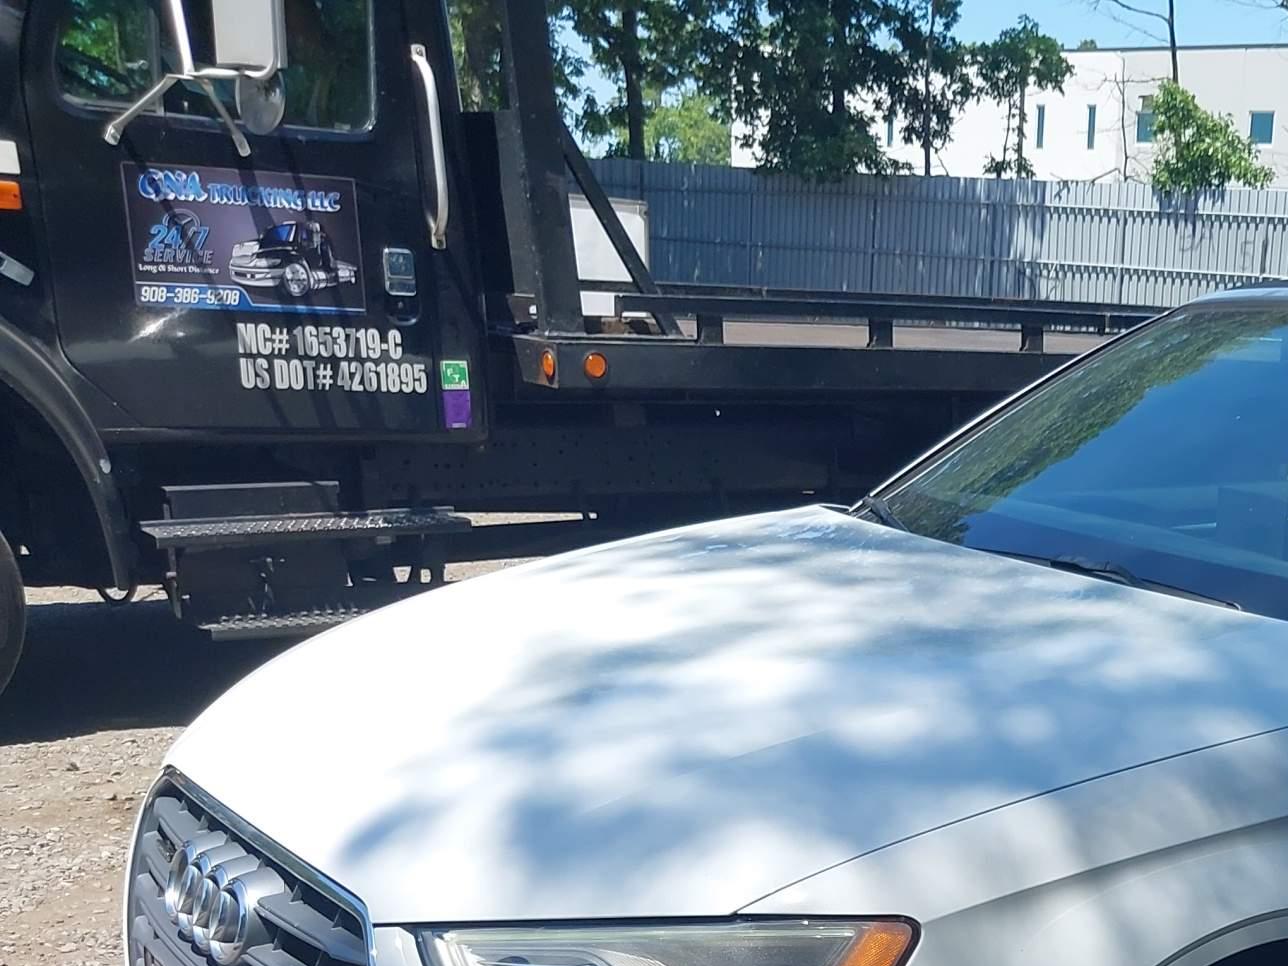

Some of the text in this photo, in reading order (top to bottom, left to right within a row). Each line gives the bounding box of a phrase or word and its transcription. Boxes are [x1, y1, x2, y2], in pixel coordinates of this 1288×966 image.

[207, 184, 305, 211] TRUCKING
[307, 190, 341, 212] LLC
[148, 224, 209, 250] 24/7
[188, 265, 220, 275] Disnce
[140, 286, 240, 306] 908-386-9208
[236, 323, 402, 360] MC# 1653719-C
[239, 358, 428, 394] US DOT# 4261895
